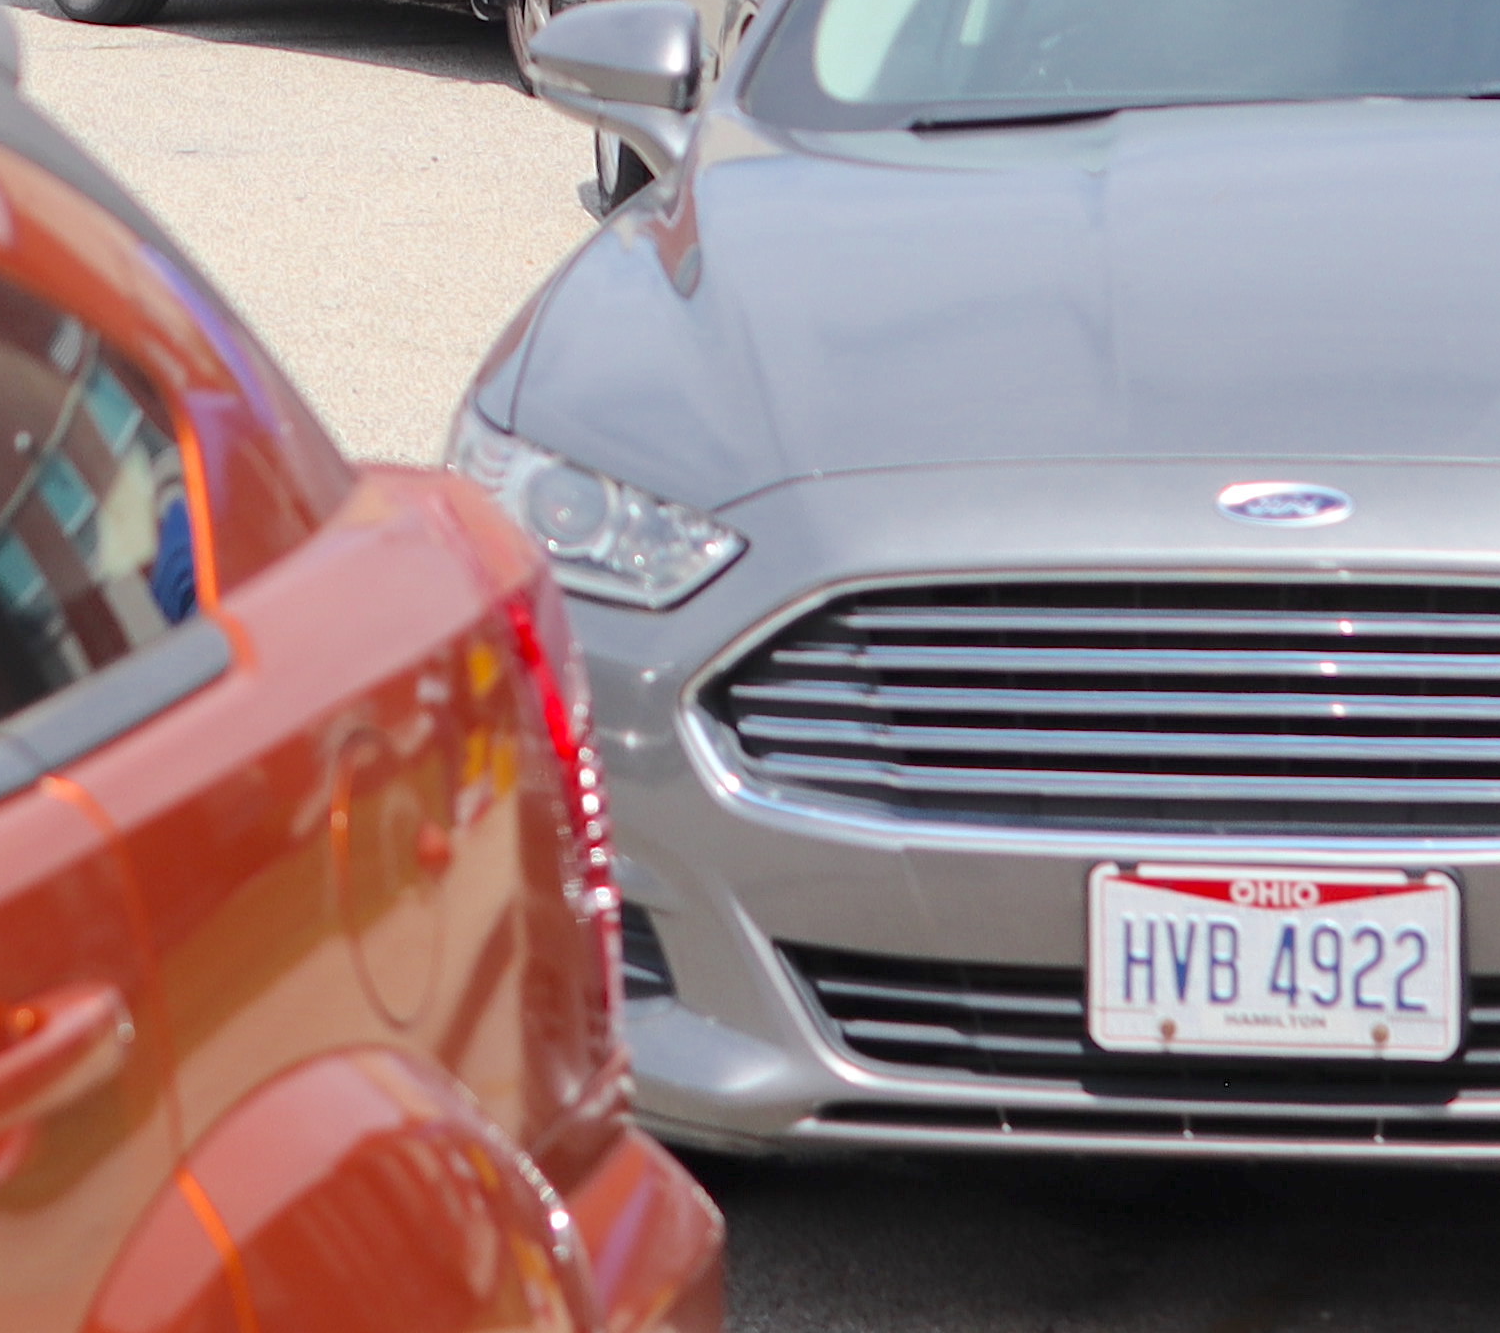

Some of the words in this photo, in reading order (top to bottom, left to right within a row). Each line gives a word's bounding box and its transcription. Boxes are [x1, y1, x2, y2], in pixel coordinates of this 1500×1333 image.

[1229, 879, 1321, 907] OHIO
[1120, 915, 1240, 1007] HVB
[1268, 923, 1429, 1013] 4922
